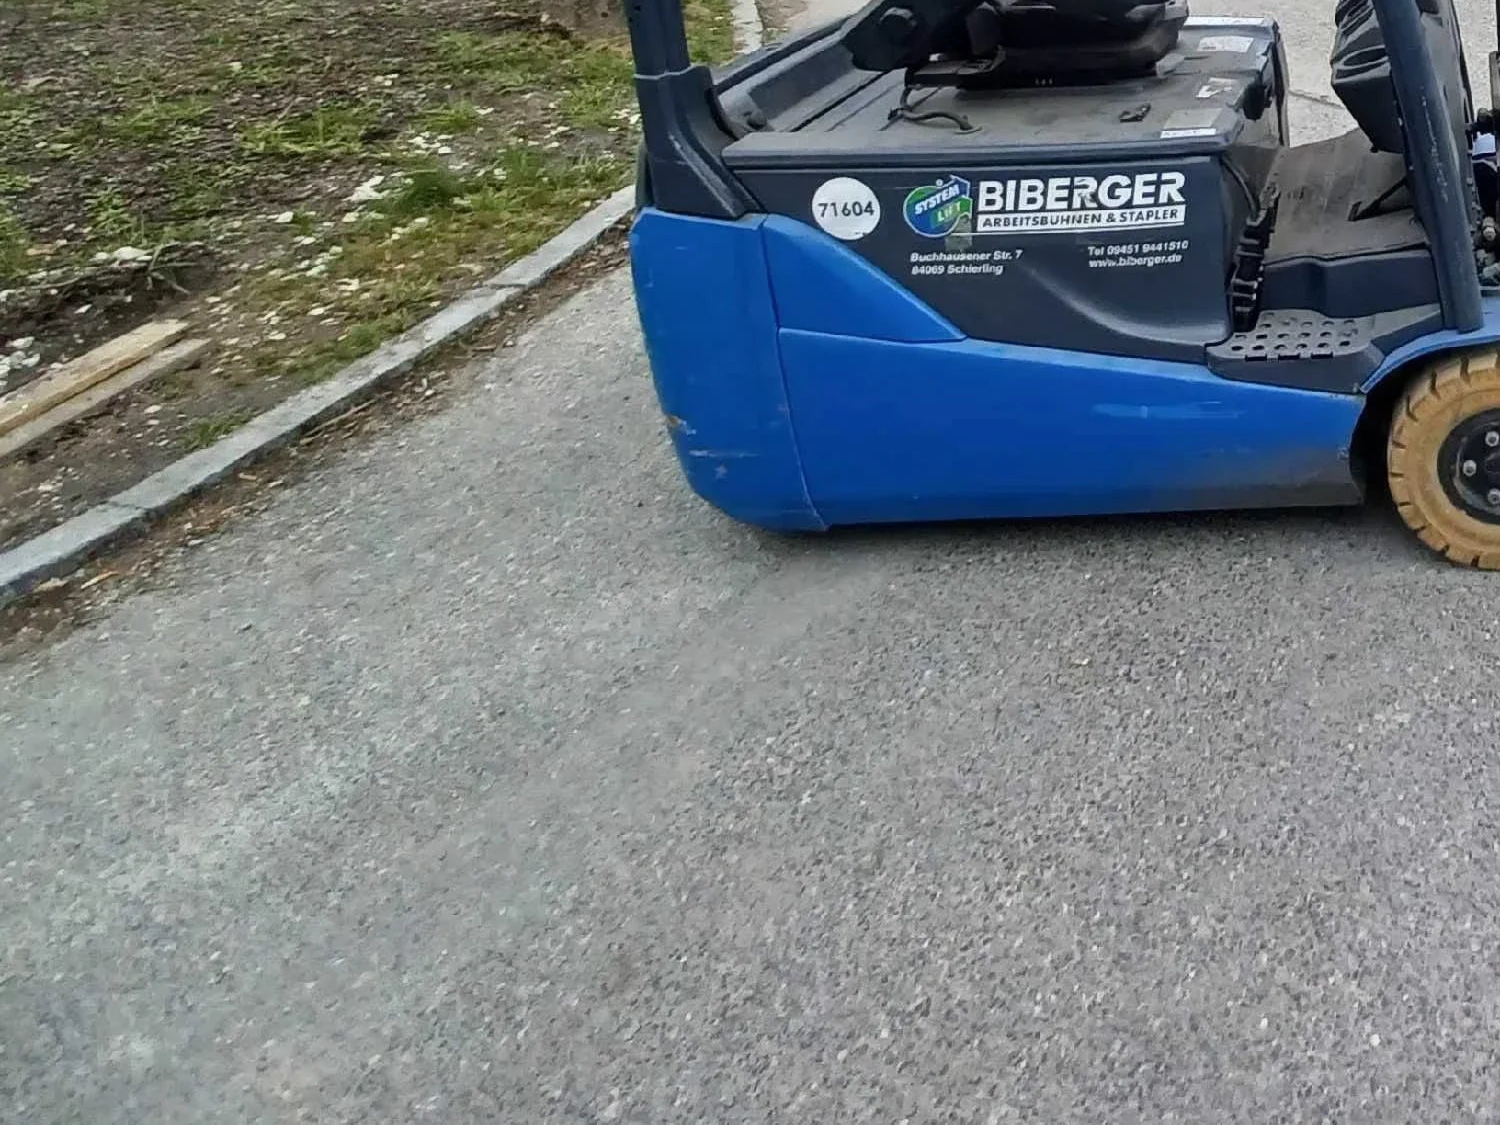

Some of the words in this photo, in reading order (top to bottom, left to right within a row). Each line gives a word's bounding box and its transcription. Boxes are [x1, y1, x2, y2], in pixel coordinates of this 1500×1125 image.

[914, 184, 960, 215] SYSTEM
[978, 172, 1185, 212] BIBERGER
[817, 200, 875, 218] 71604
[937, 201, 961, 222] LIFT
[1106, 212, 1117, 223] &
[1119, 209, 1179, 223] STAPLER
[910, 252, 992, 263] Buchhausener
[993, 250, 1013, 261] Str.
[1014, 249, 1024, 259] 7
[1106, 244, 1140, 256] 09451
[1088, 253, 1183, 268] www.biberger.de
[947, 263, 1004, 276] Schierling
